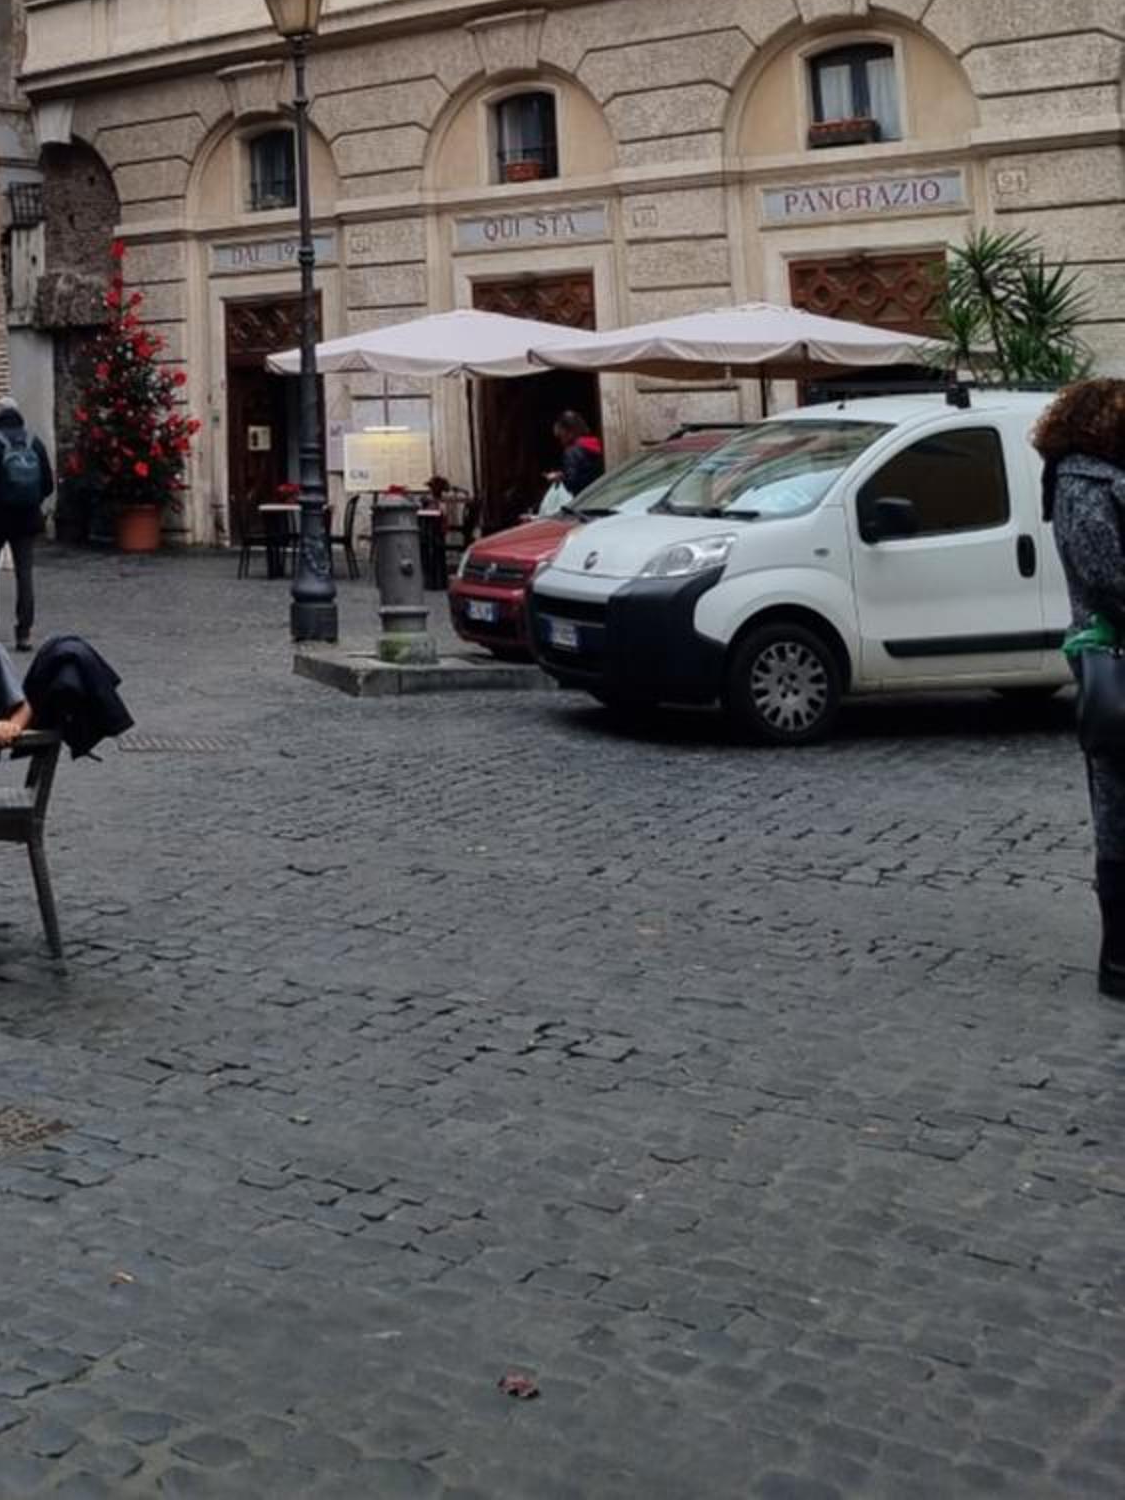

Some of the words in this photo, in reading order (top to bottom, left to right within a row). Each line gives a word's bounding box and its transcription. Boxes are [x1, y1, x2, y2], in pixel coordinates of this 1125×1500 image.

[783, 179, 941, 215] PANCRAZIO
[483, 214, 521, 242] QUI
[534, 213, 576, 237] STA
